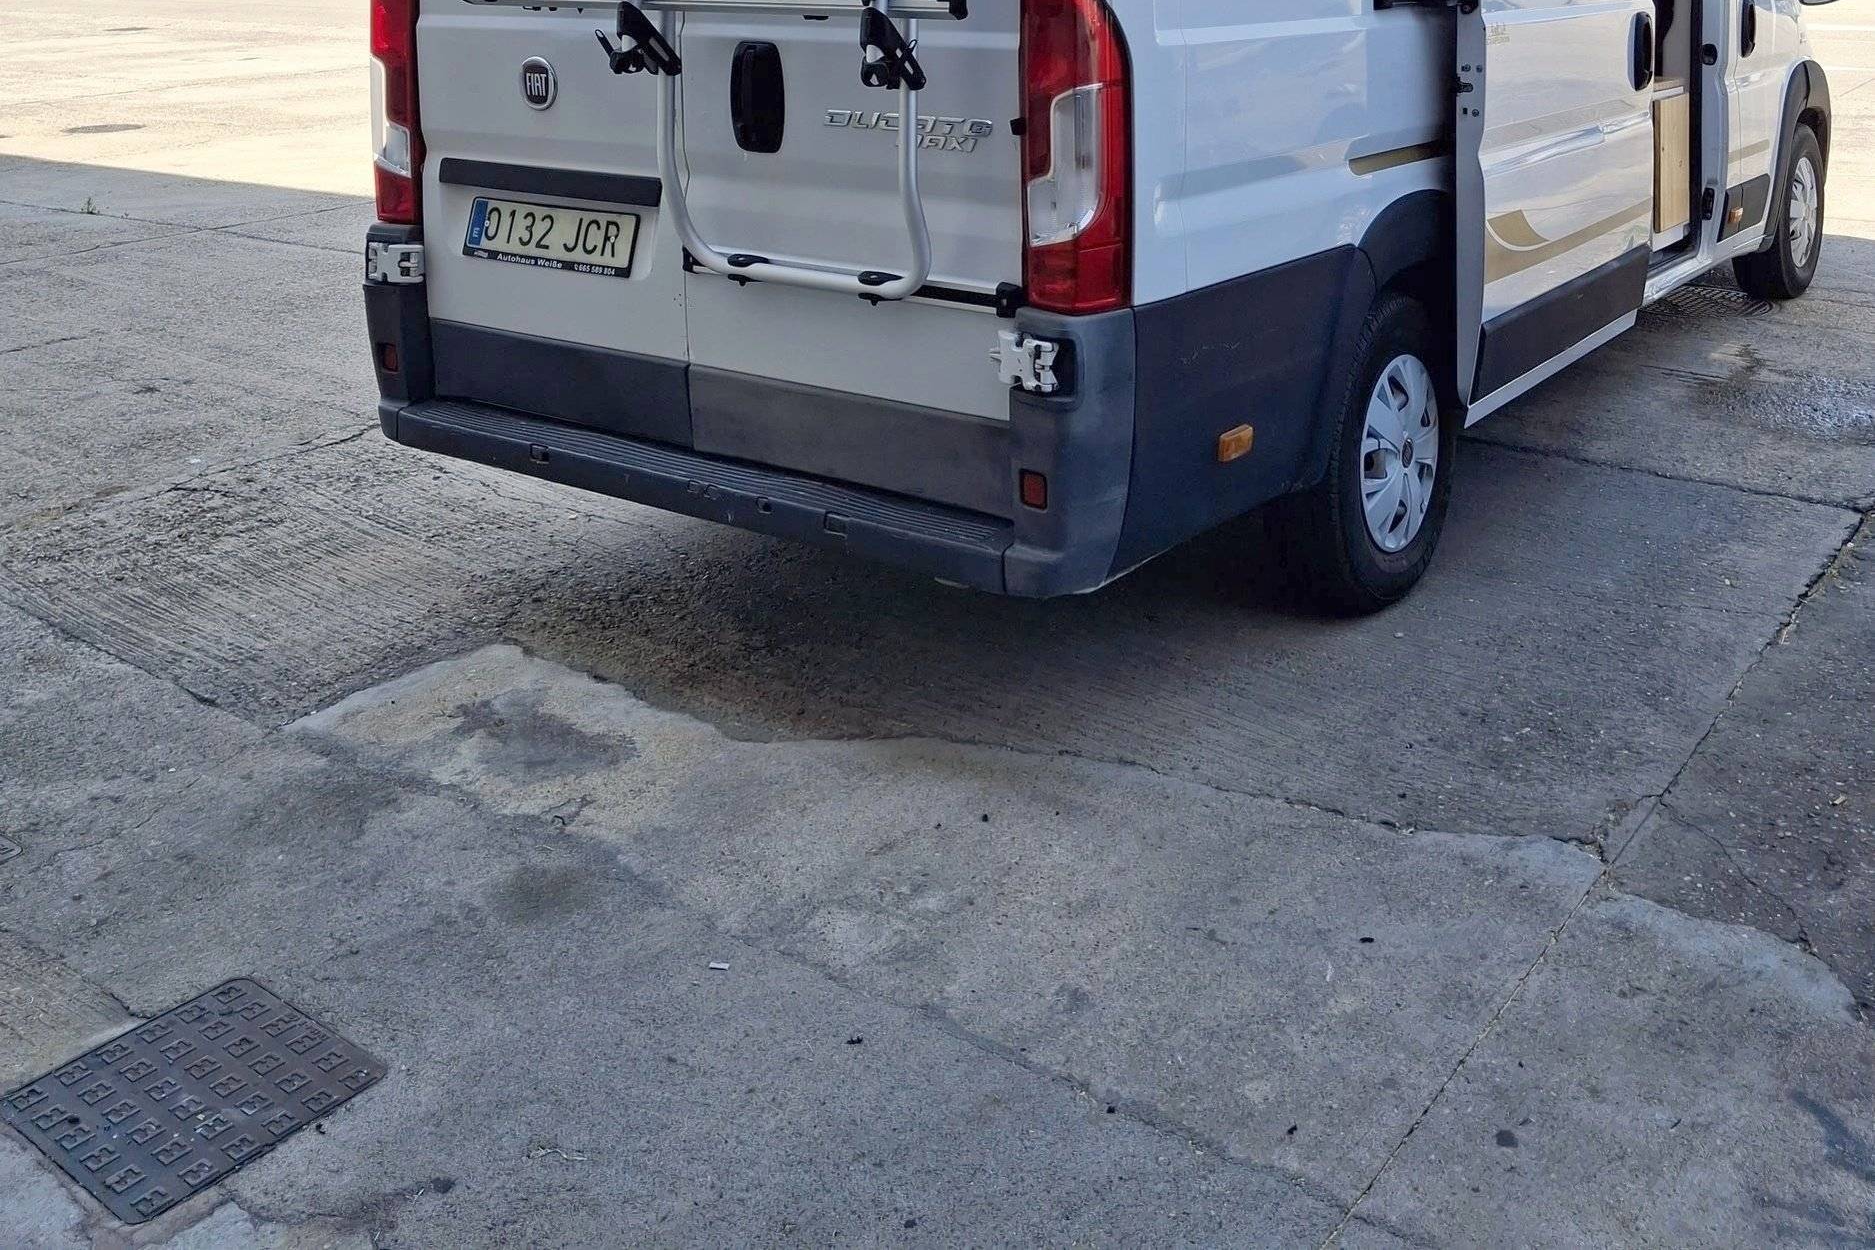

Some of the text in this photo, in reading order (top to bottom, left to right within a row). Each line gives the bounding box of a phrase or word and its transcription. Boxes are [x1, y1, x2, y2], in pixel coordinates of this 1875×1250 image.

[525, 72, 547, 97] FIAT
[897, 134, 978, 153] AXI
[484, 206, 621, 258] 0132 JCR
[496, 253, 536, 265] Autohaus
[537, 258, 563, 269] Weiße
